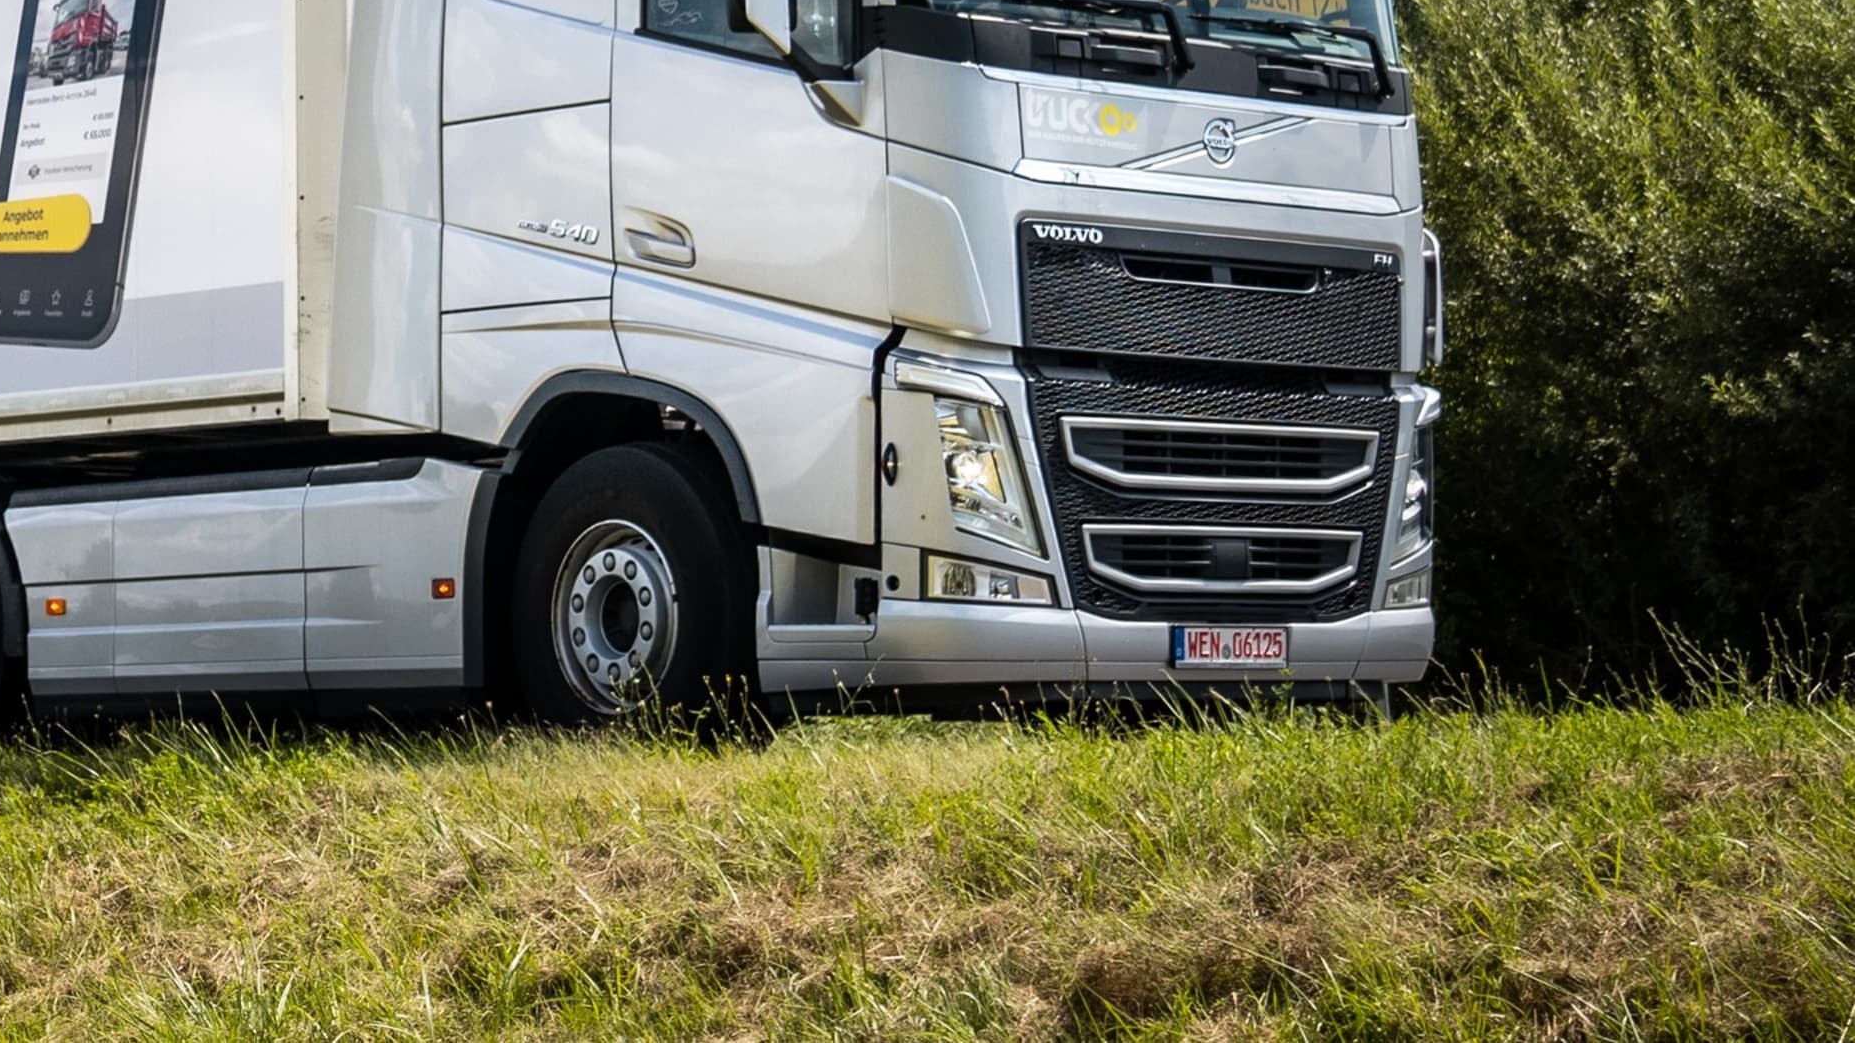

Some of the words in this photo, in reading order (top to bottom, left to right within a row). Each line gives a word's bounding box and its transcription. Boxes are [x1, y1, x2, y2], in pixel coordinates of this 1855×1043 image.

[2, 208, 44, 226] Angebot
[550, 219, 600, 245] 540
[1032, 224, 1103, 244] VOLVO
[1374, 253, 1393, 266] FH
[1187, 631, 1221, 659] WEN
[1232, 631, 1283, 659] 06125
